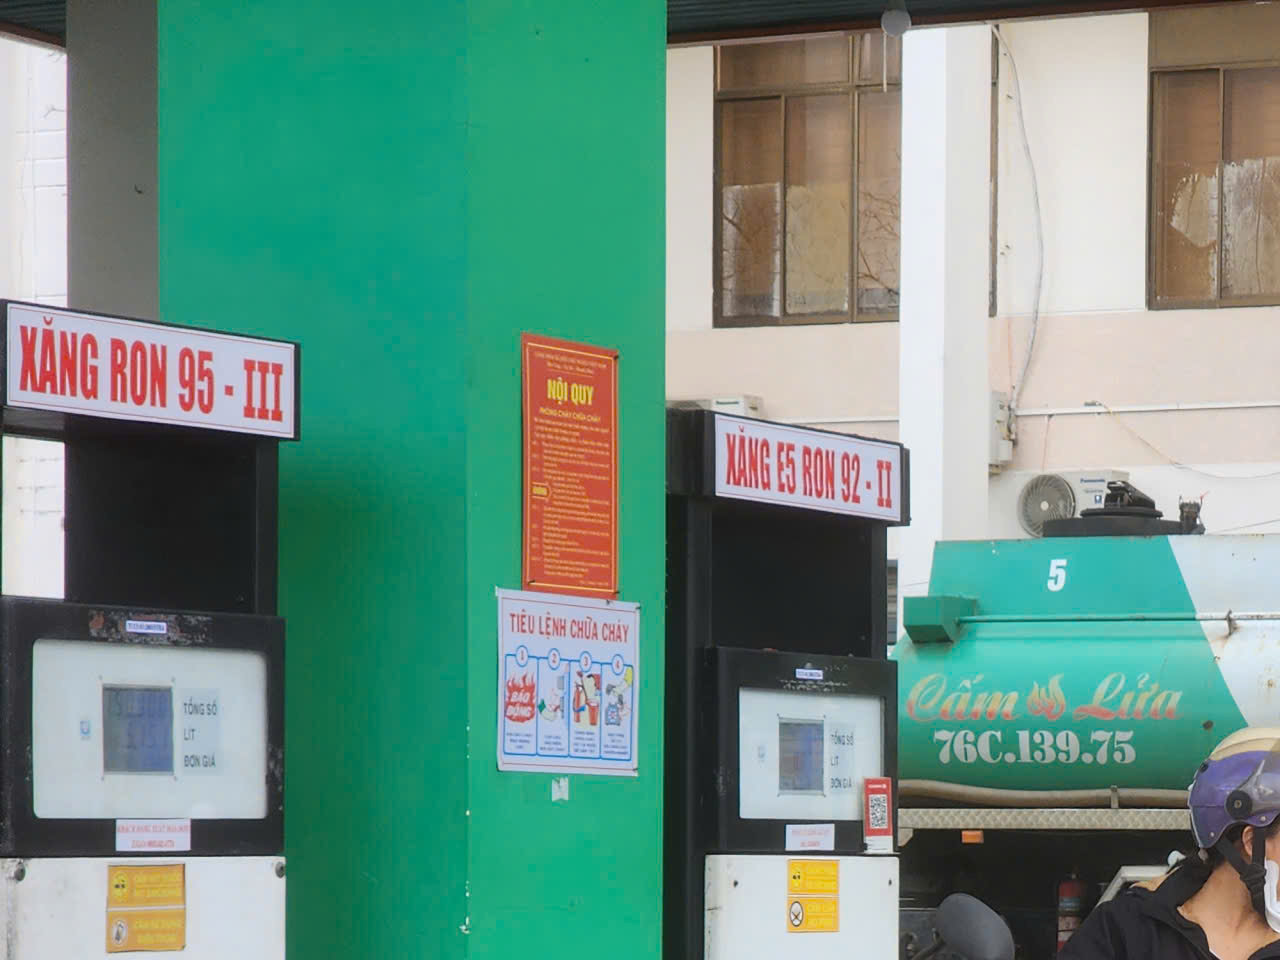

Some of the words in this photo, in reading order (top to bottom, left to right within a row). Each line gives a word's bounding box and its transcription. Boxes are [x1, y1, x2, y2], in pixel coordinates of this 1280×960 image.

[20, 316, 99, 400] XĂNG
[110, 338, 167, 408] RON
[178, 347, 214, 414] 95
[243, 359, 283, 422] III
[547, 377, 568, 405] NỘI
[571, 382, 593, 405] QUY
[726, 425, 771, 491] XĂNG
[777, 441, 796, 495] E5
[802, 445, 835, 500] RON
[841, 451, 861, 504] 92
[876, 459, 892, 508] II
[1047, 559, 1067, 592] 5
[538, 611, 566, 639] LỆNH
[933, 729, 1136, 765] 76C.139.75
